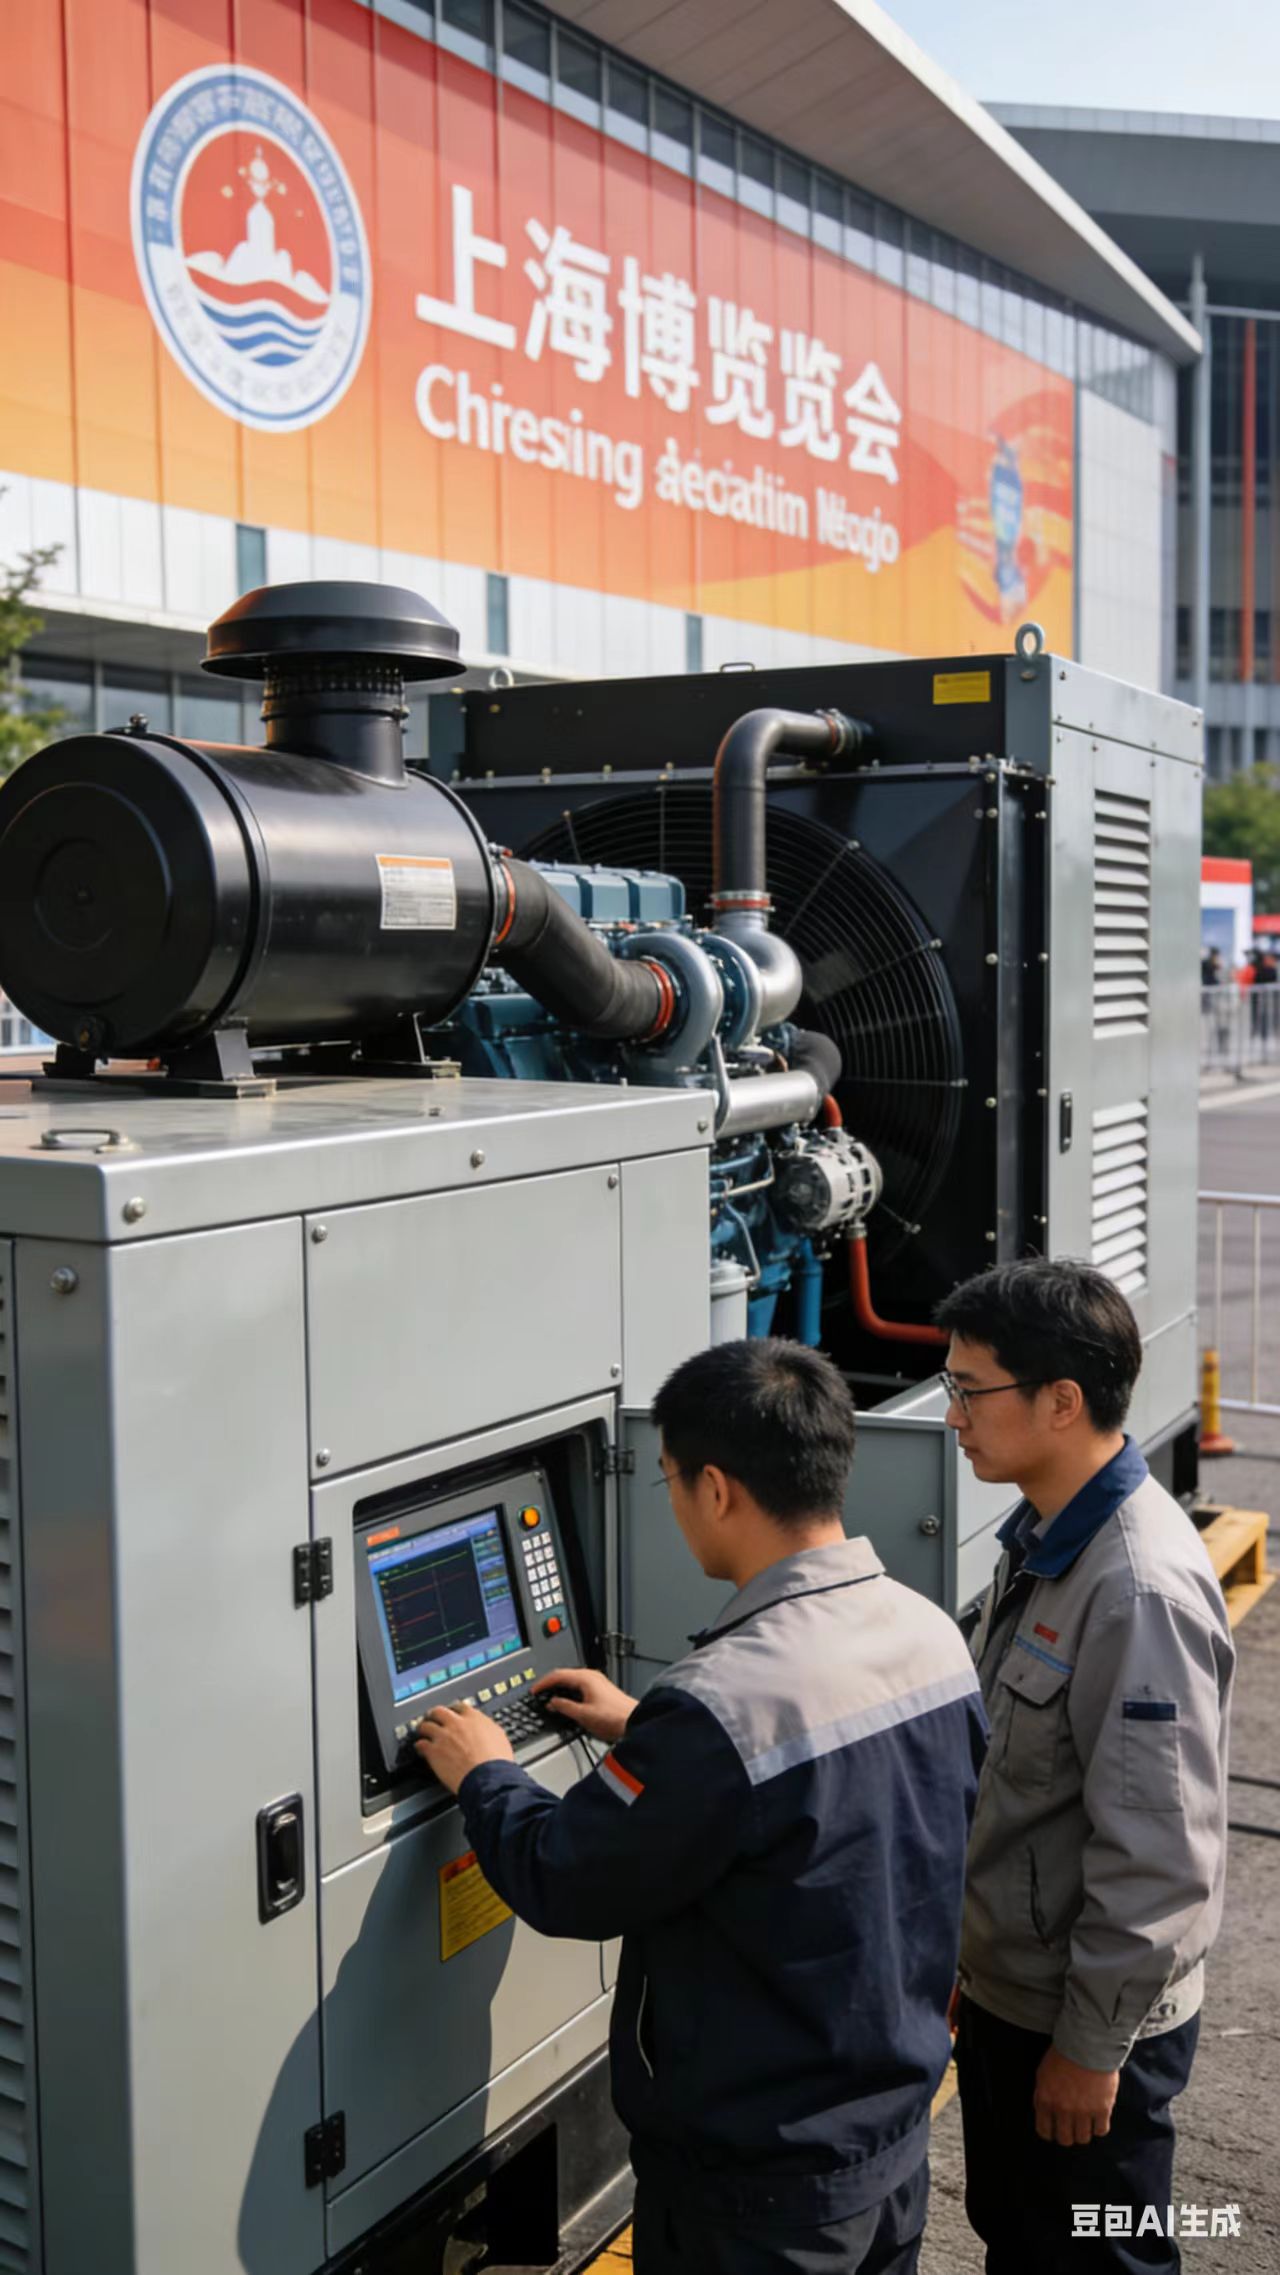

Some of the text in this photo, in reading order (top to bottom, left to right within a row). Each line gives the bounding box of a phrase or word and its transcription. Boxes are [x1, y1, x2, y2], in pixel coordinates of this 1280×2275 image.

[415, 183, 901, 485] 上海博览览会
